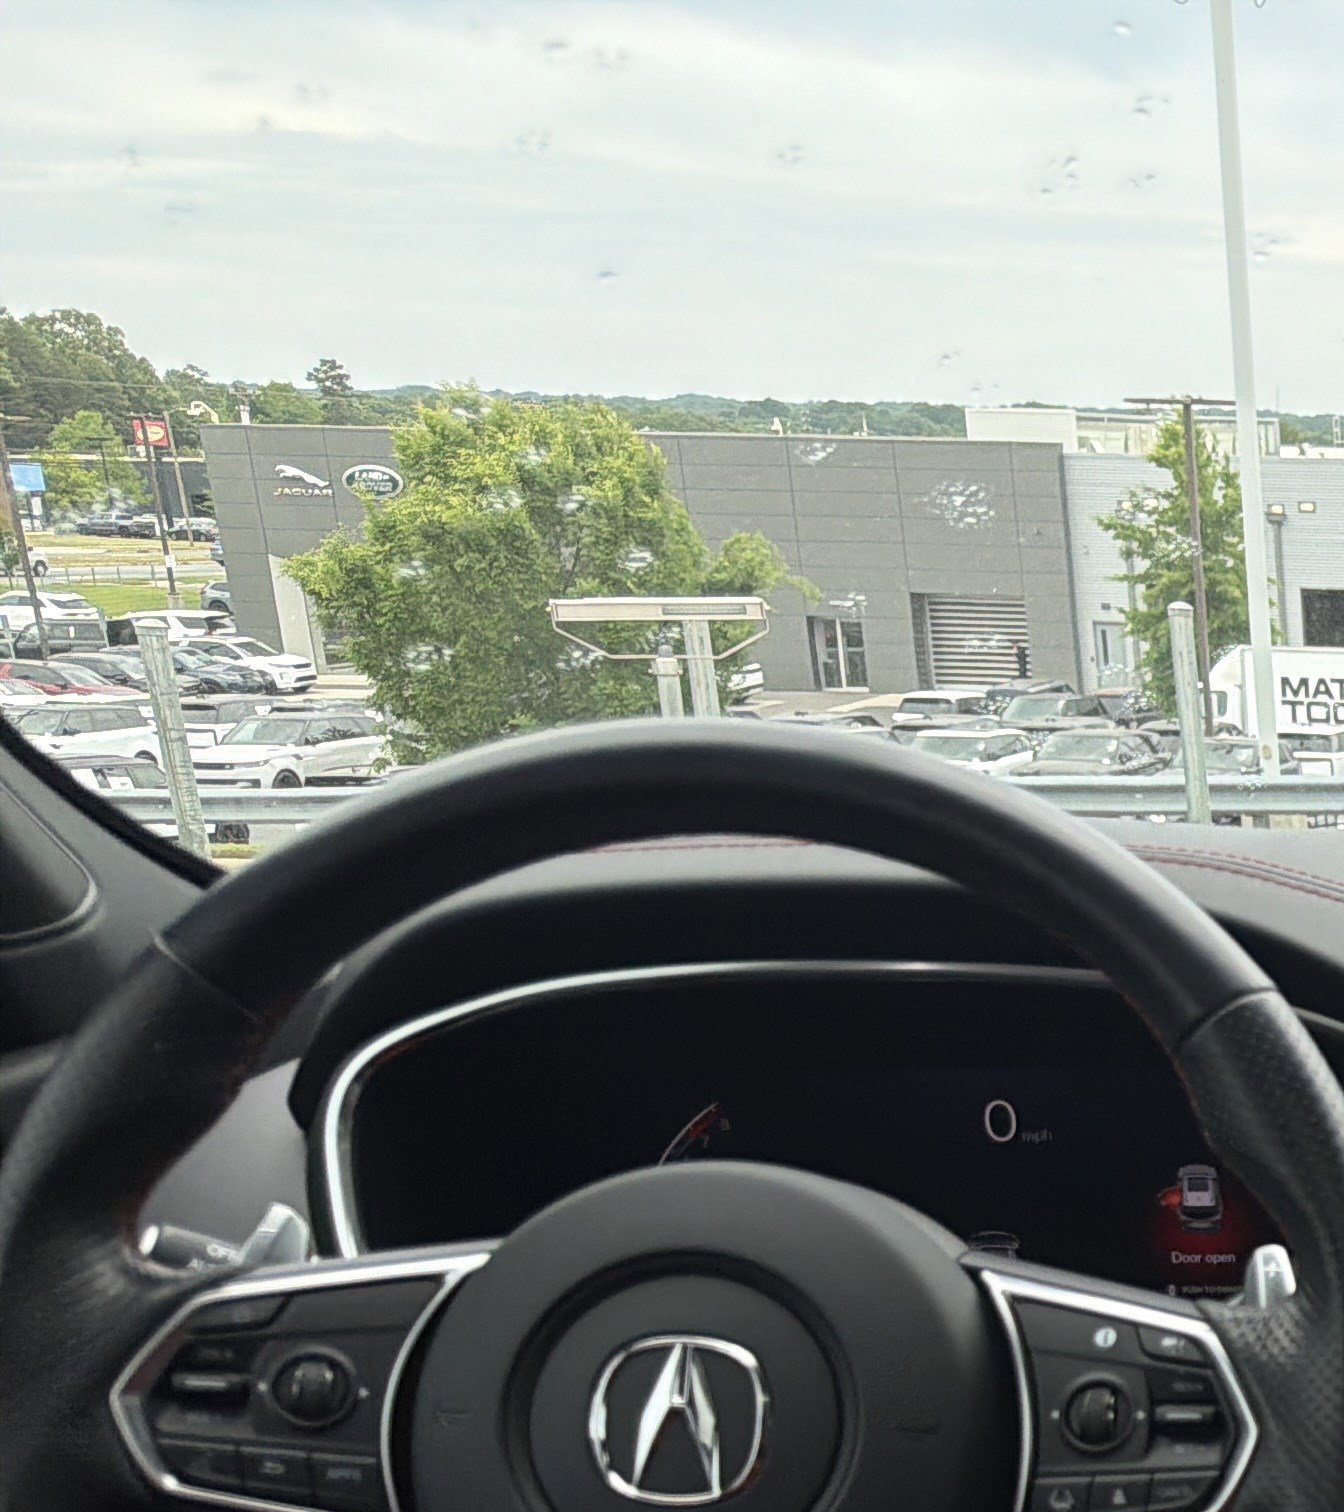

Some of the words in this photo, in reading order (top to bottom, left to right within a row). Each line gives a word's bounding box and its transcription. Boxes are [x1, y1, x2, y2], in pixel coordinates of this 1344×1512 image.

[273, 487, 333, 497] JAGUAR
[984, 1099, 1018, 1143] 0
[1021, 1128, 1054, 1145] mph
[1170, 1250, 1202, 1264] Door
[1204, 1253, 1236, 1265] open
